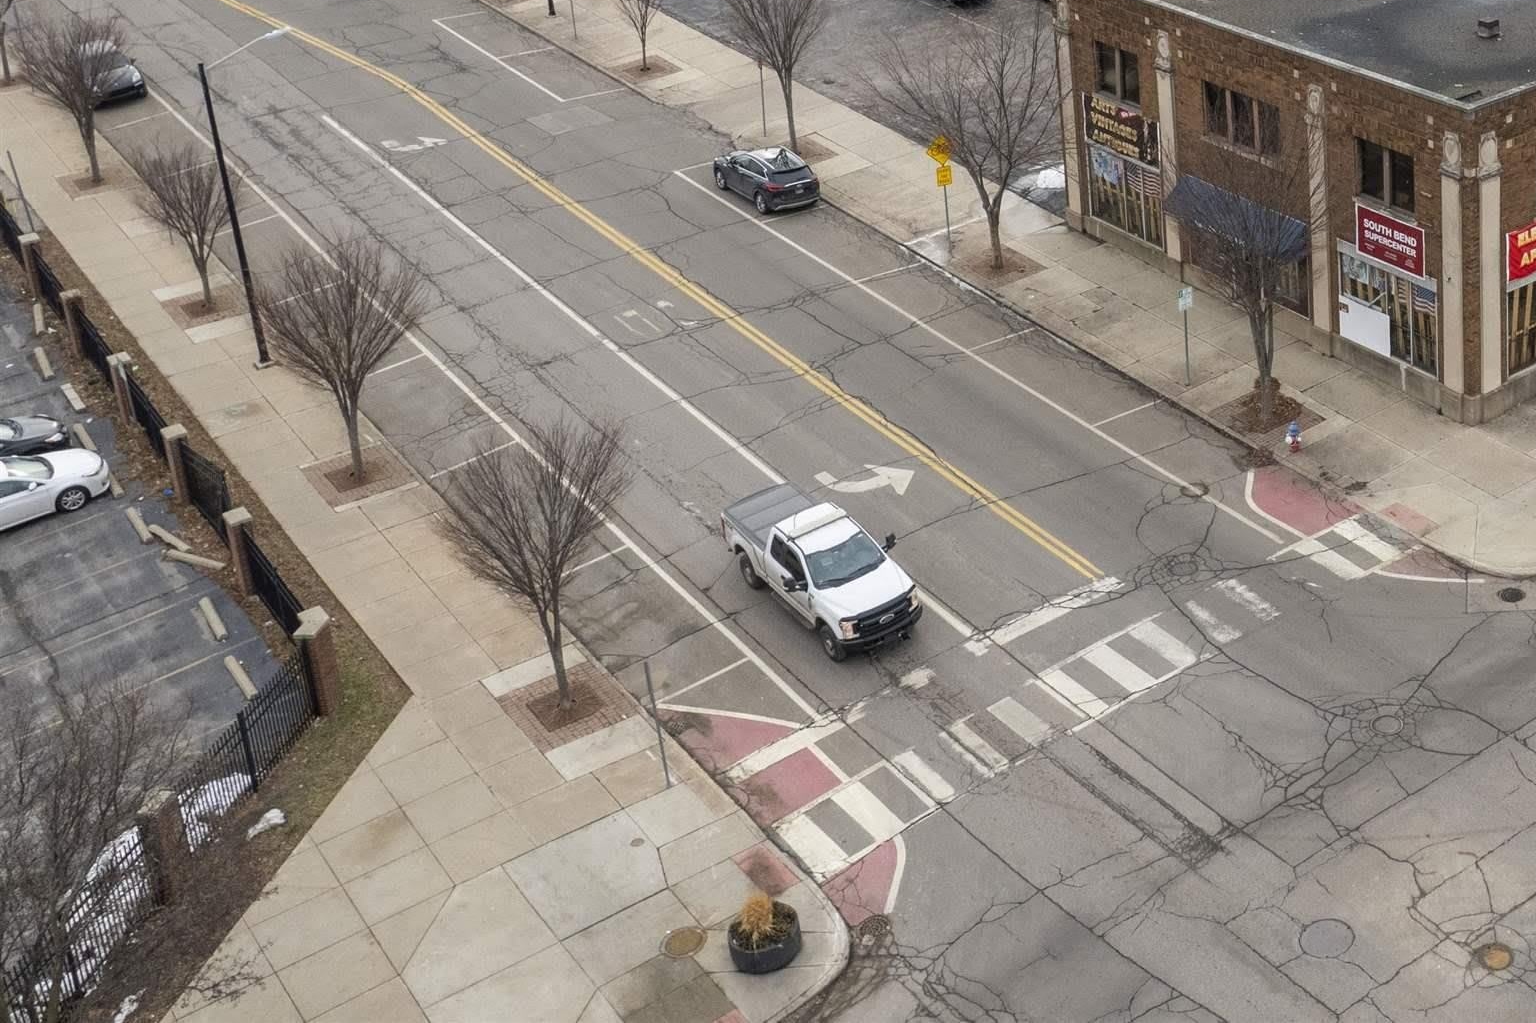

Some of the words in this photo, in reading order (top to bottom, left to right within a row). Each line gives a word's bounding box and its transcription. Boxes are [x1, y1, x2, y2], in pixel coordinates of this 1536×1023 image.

[1363, 218, 1392, 238] SOUTH
[1393, 230, 1417, 247] BEND
[1363, 229, 1417, 258] SUPERCENTER
